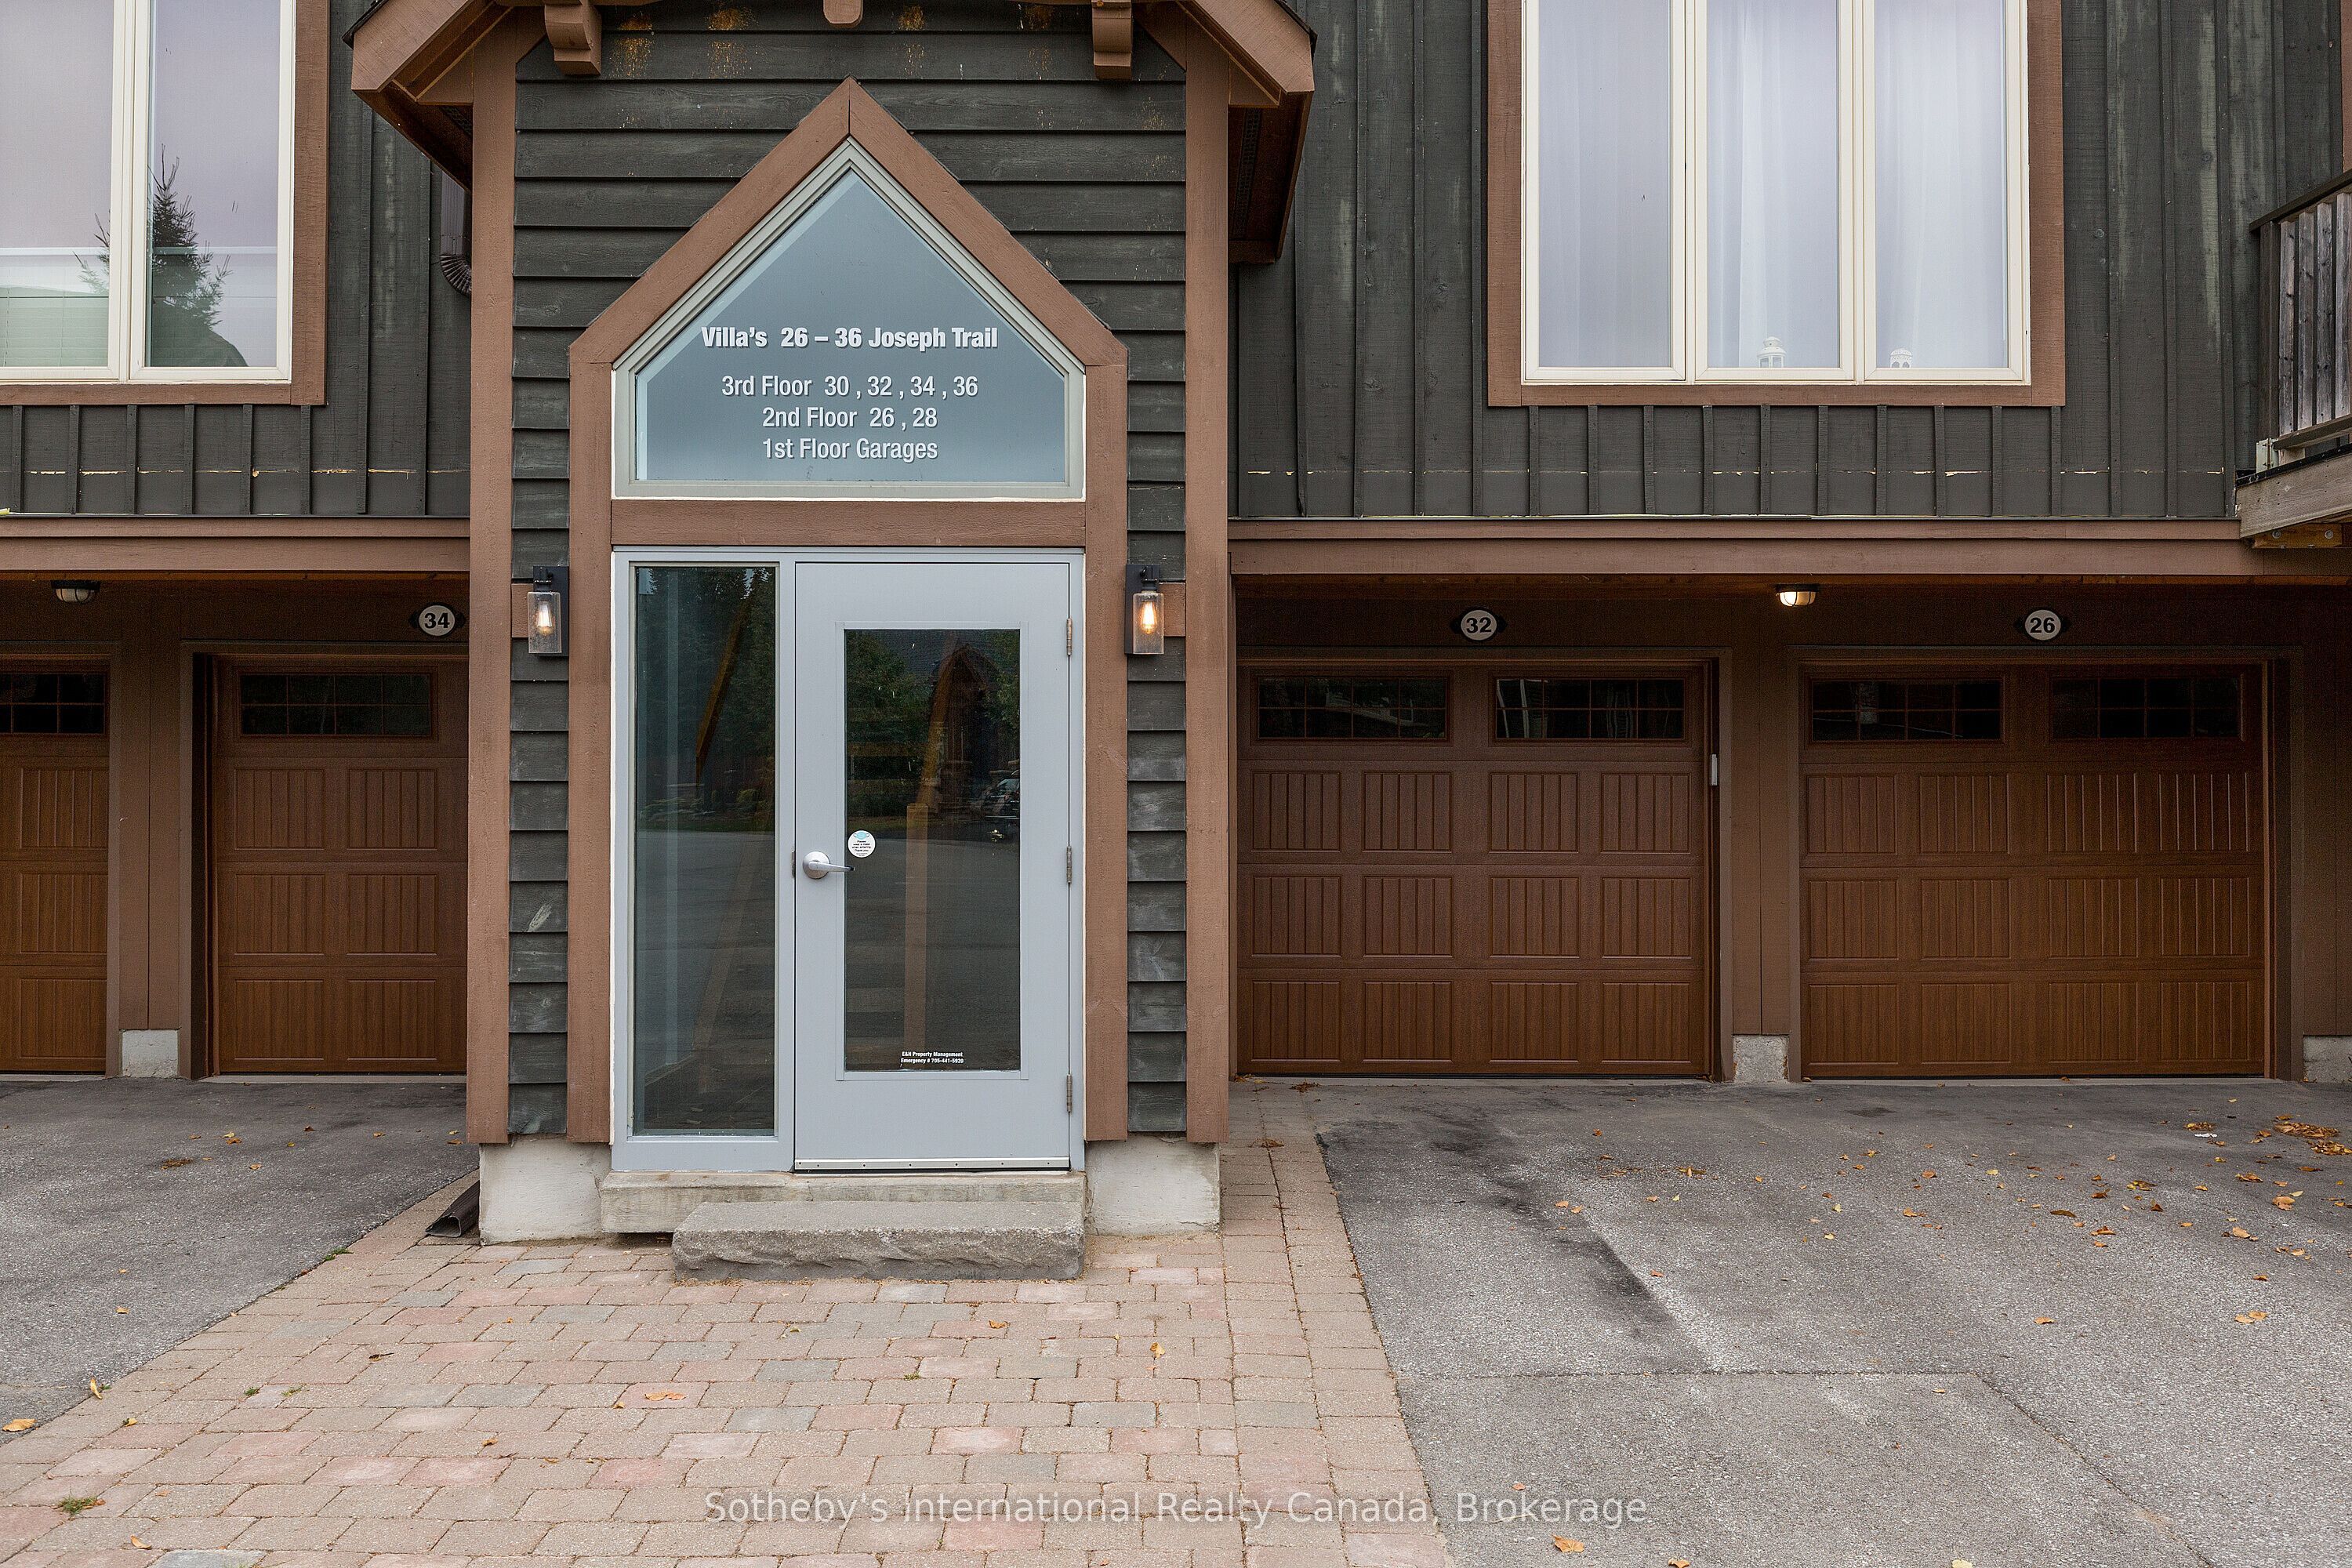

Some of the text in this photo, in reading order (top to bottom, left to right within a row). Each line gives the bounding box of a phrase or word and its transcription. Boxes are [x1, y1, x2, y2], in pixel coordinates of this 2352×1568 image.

[702, 327, 768, 347] Villa’s
[781, 327, 808, 347] 26
[835, 327, 862, 347] 36
[868, 327, 946, 351] Joseph
[952, 327, 997, 347] Trail
[721, 376, 754, 395] 3rd
[762, 376, 812, 395] Floor
[824, 376, 849, 395] 30
[867, 376, 892, 395] 32
[910, 376, 935, 395] 34
[953, 376, 978, 395] 36
[763, 407, 800, 427] 2nd
[808, 407, 858, 427] Floor
[869, 407, 895, 427] 26
[913, 407, 938, 427] 28
[763, 438, 938, 463] 1st Floor Garages
[424, 612, 450, 629] 34
[1466, 617, 1492, 633] 32
[2030, 617, 2055, 633] 26
